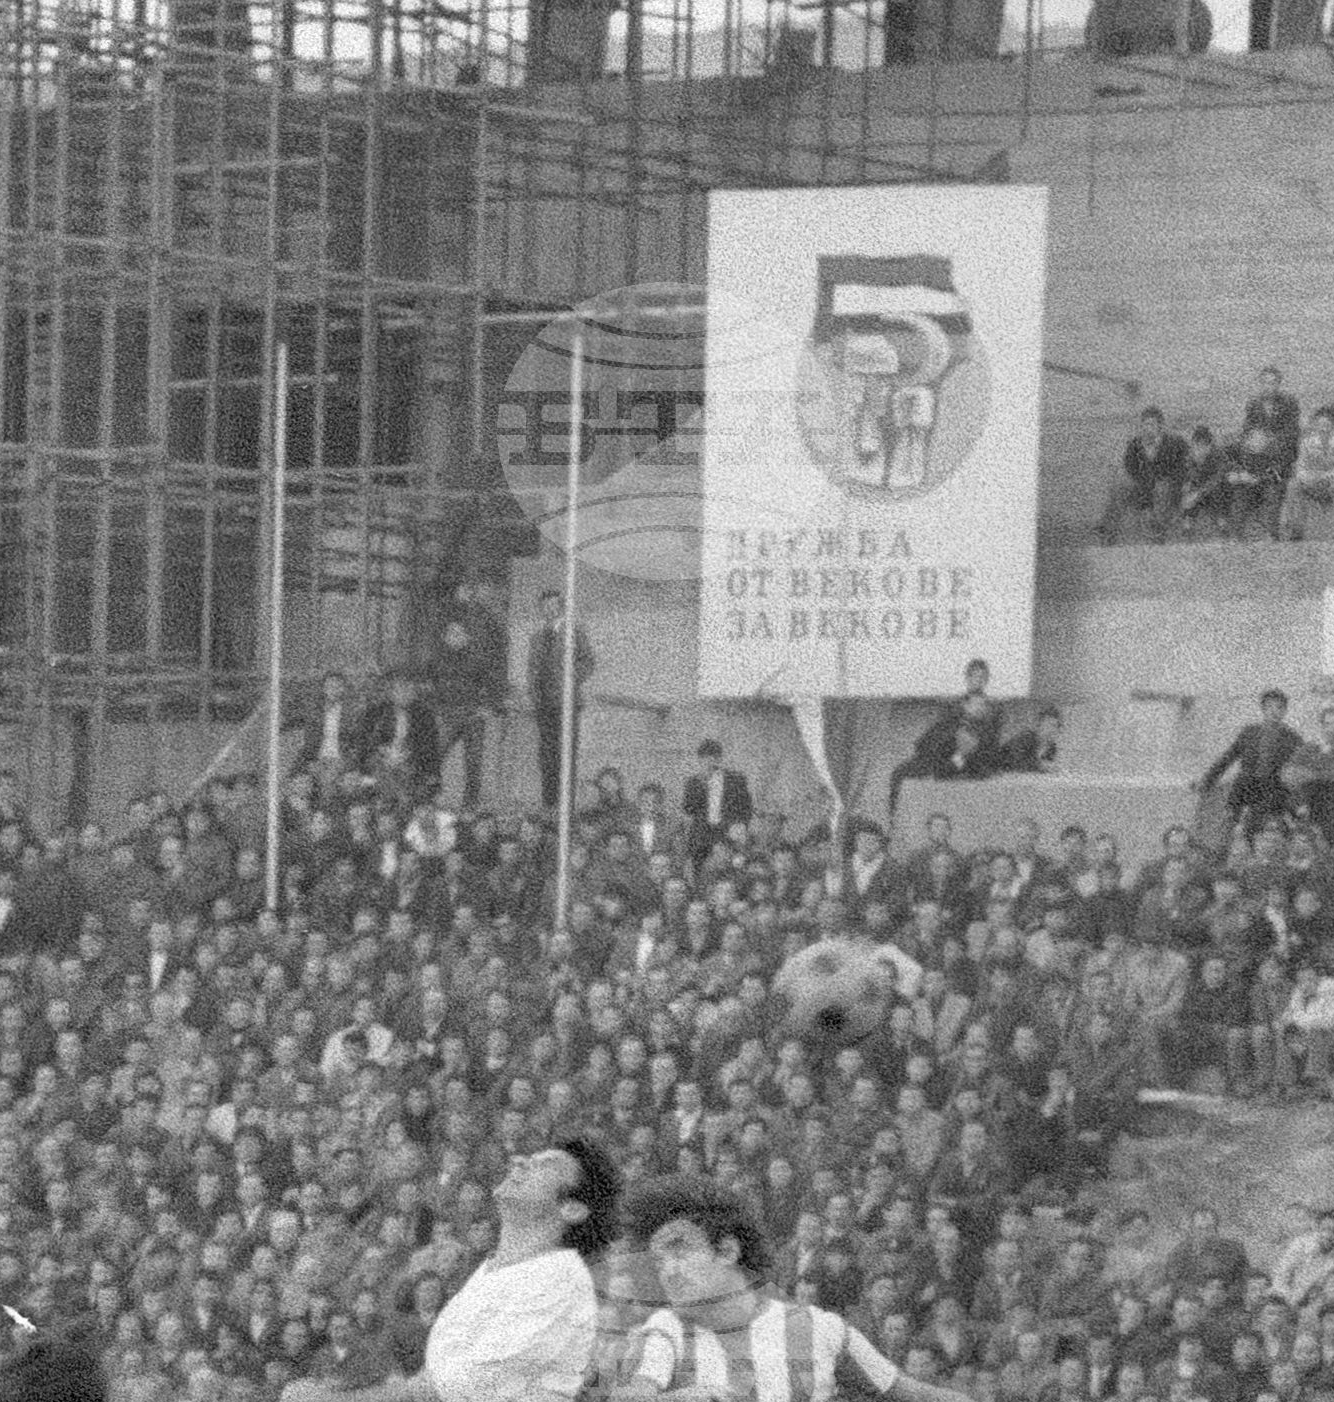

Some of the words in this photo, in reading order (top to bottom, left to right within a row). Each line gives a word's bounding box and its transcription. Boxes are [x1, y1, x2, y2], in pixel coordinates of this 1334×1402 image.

[726, 566, 772, 599] ОТ
[788, 566, 974, 599] ВЕКОВЕ
[726, 608, 772, 640] ЗА
[788, 608, 972, 640] ВЕКОВЕ
